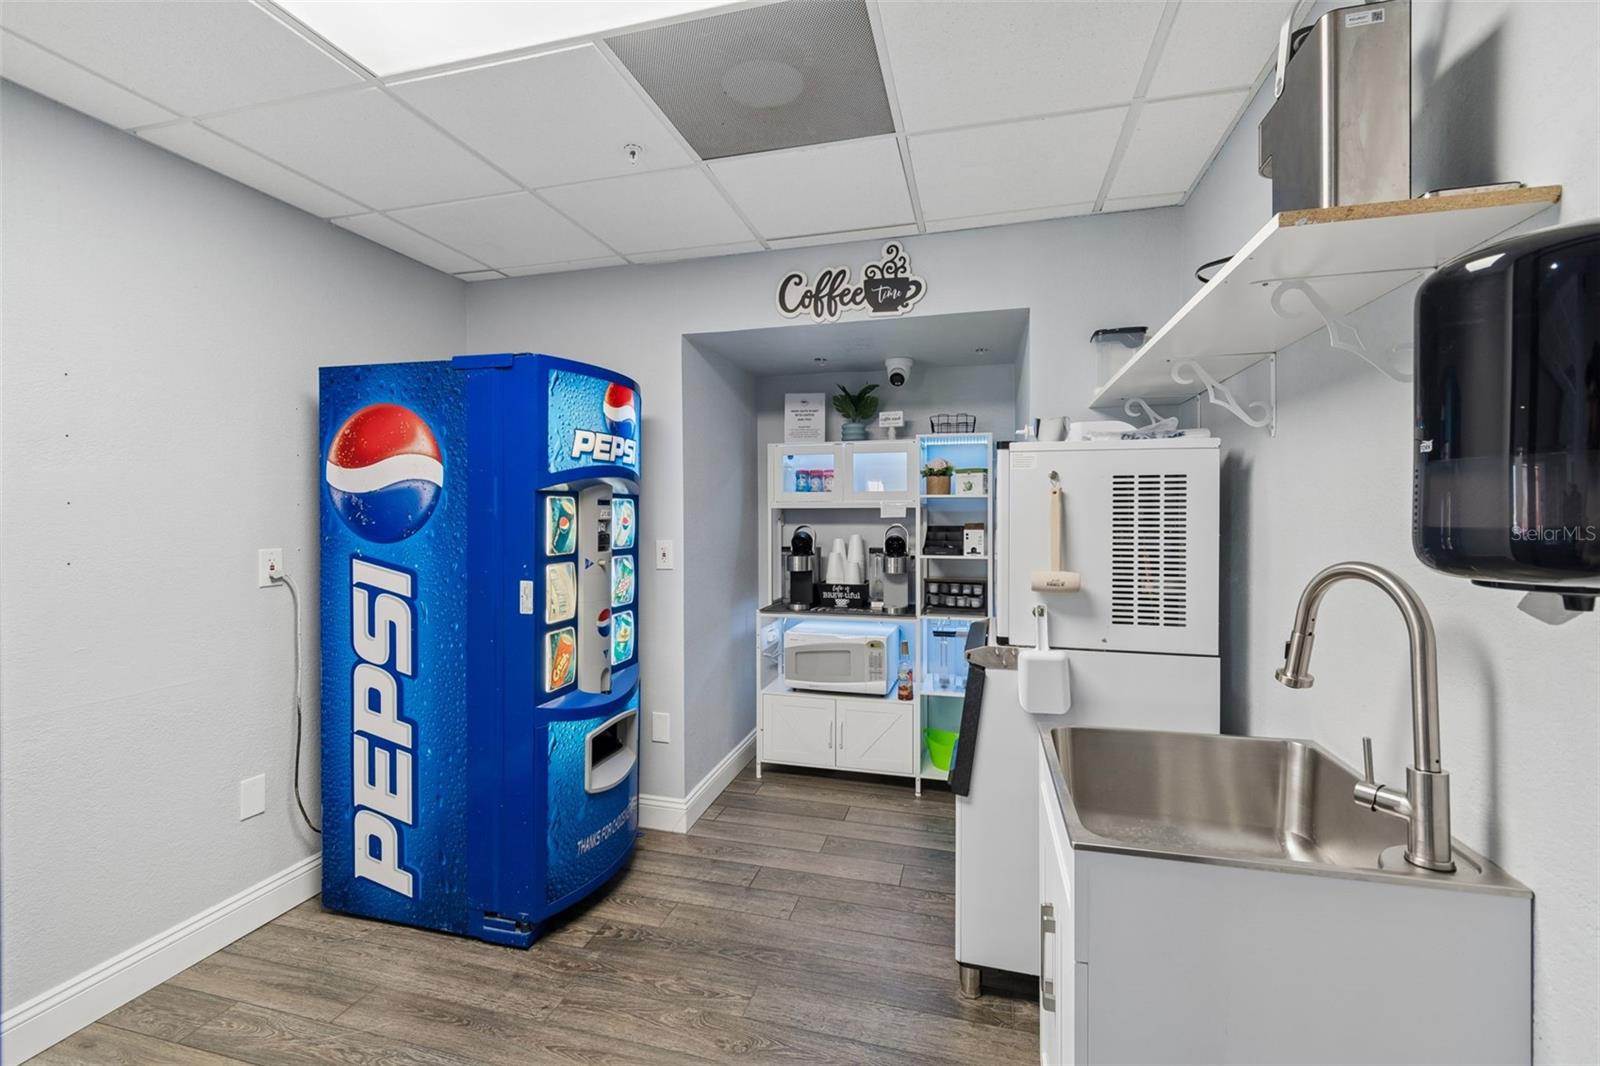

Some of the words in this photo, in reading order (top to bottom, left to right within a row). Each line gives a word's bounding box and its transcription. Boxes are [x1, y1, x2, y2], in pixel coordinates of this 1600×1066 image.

[779, 269, 866, 318] Coffee
[871, 285, 901, 304] time
[571, 429, 637, 465] PEPSI
[352, 558, 413, 898] PEPSI
[577, 830, 601, 856] THANKS
[601, 822, 612, 840] FOR
